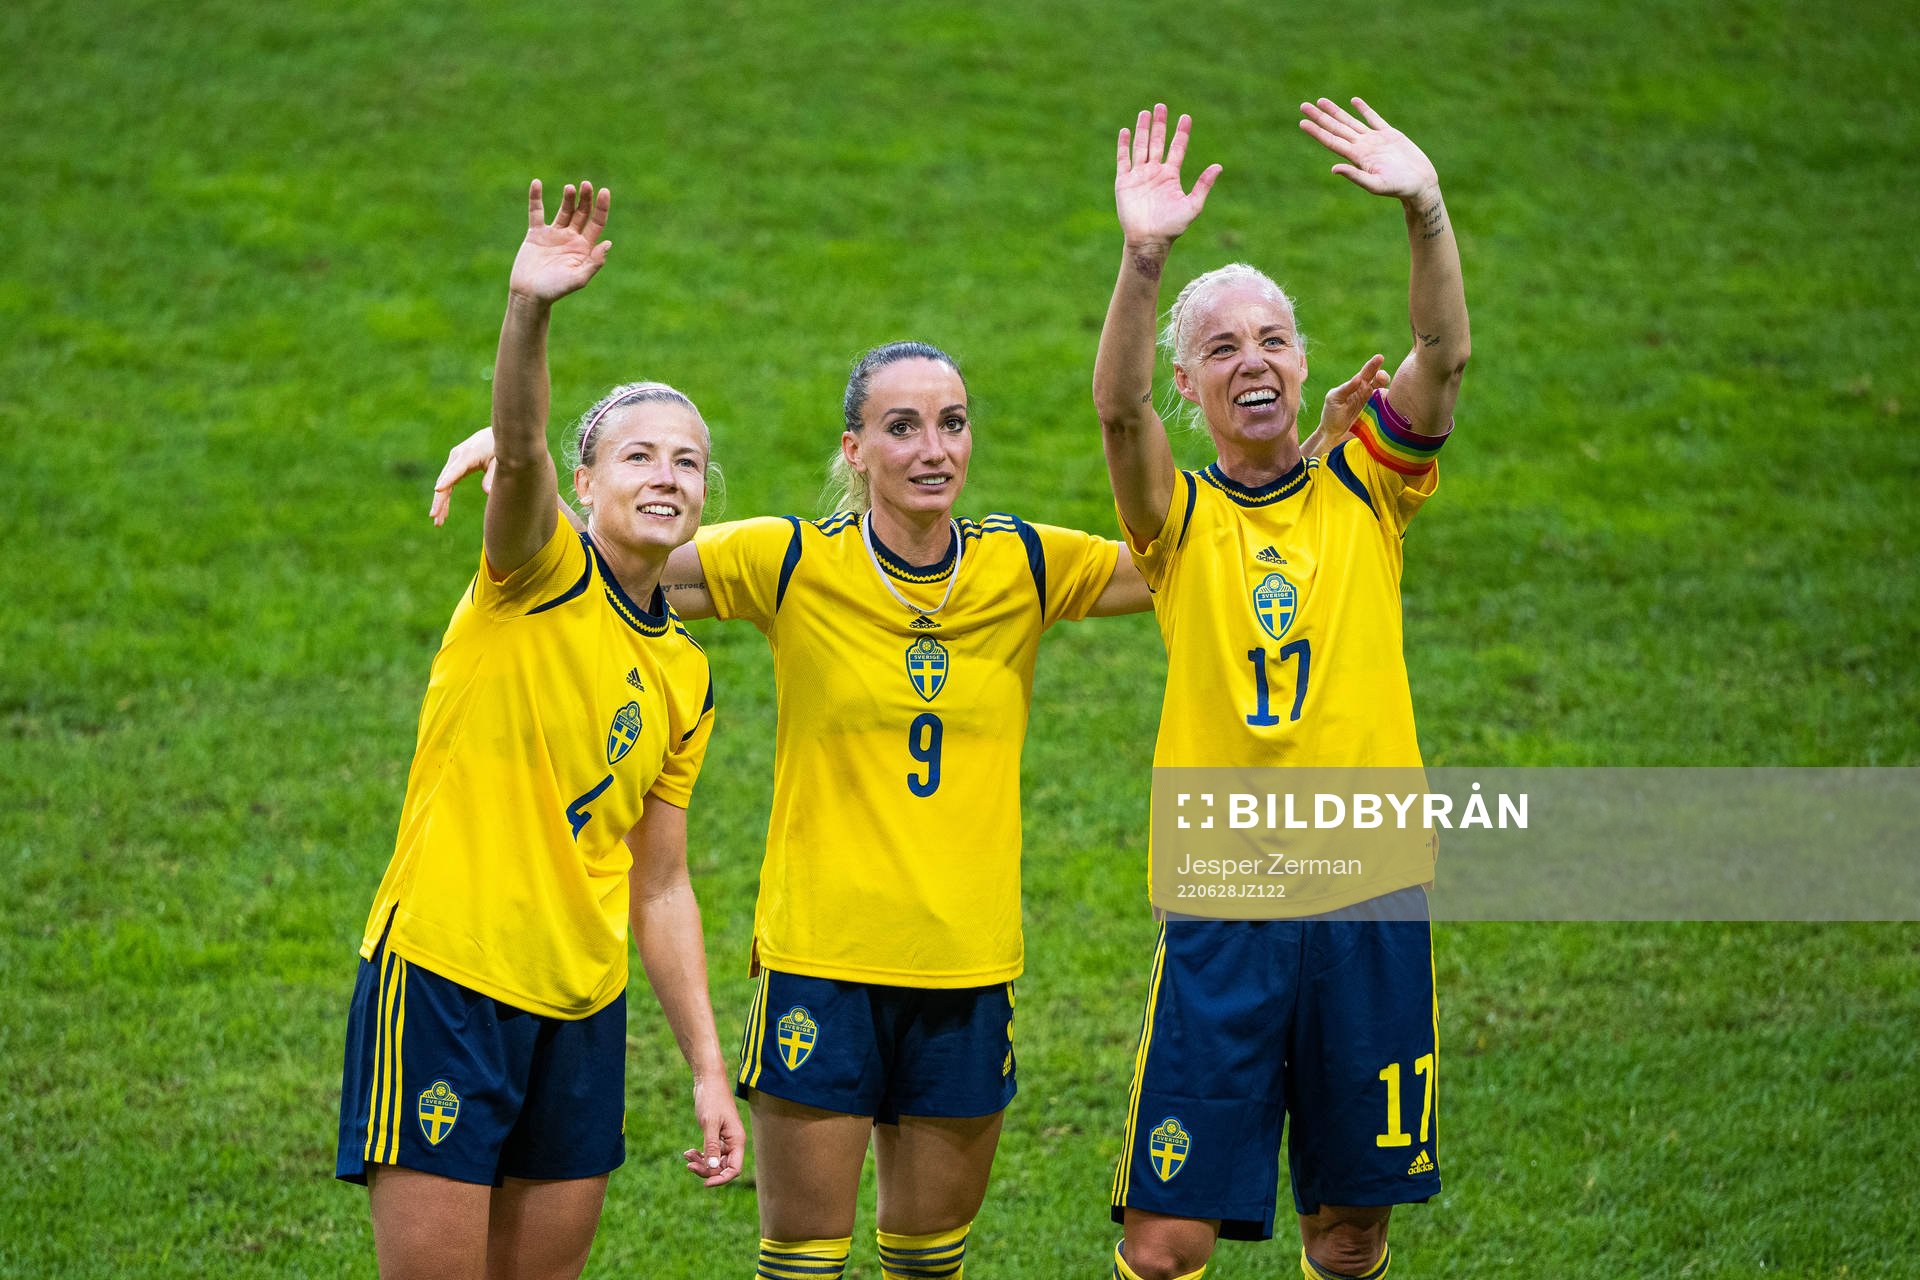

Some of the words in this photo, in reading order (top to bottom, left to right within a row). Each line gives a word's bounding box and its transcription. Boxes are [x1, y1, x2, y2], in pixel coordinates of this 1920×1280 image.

[1256, 555, 1288, 565] adidas
[1246, 638, 1312, 727] 17
[907, 712, 944, 798] 9
[784, 1023, 811, 1033] SVERIGE
[425, 1098, 454, 1107] SVERIGE
[1376, 1053, 1434, 1147] 17
[1156, 1135, 1184, 1145] SVERIGE
[1407, 1162, 1434, 1175] adidas
